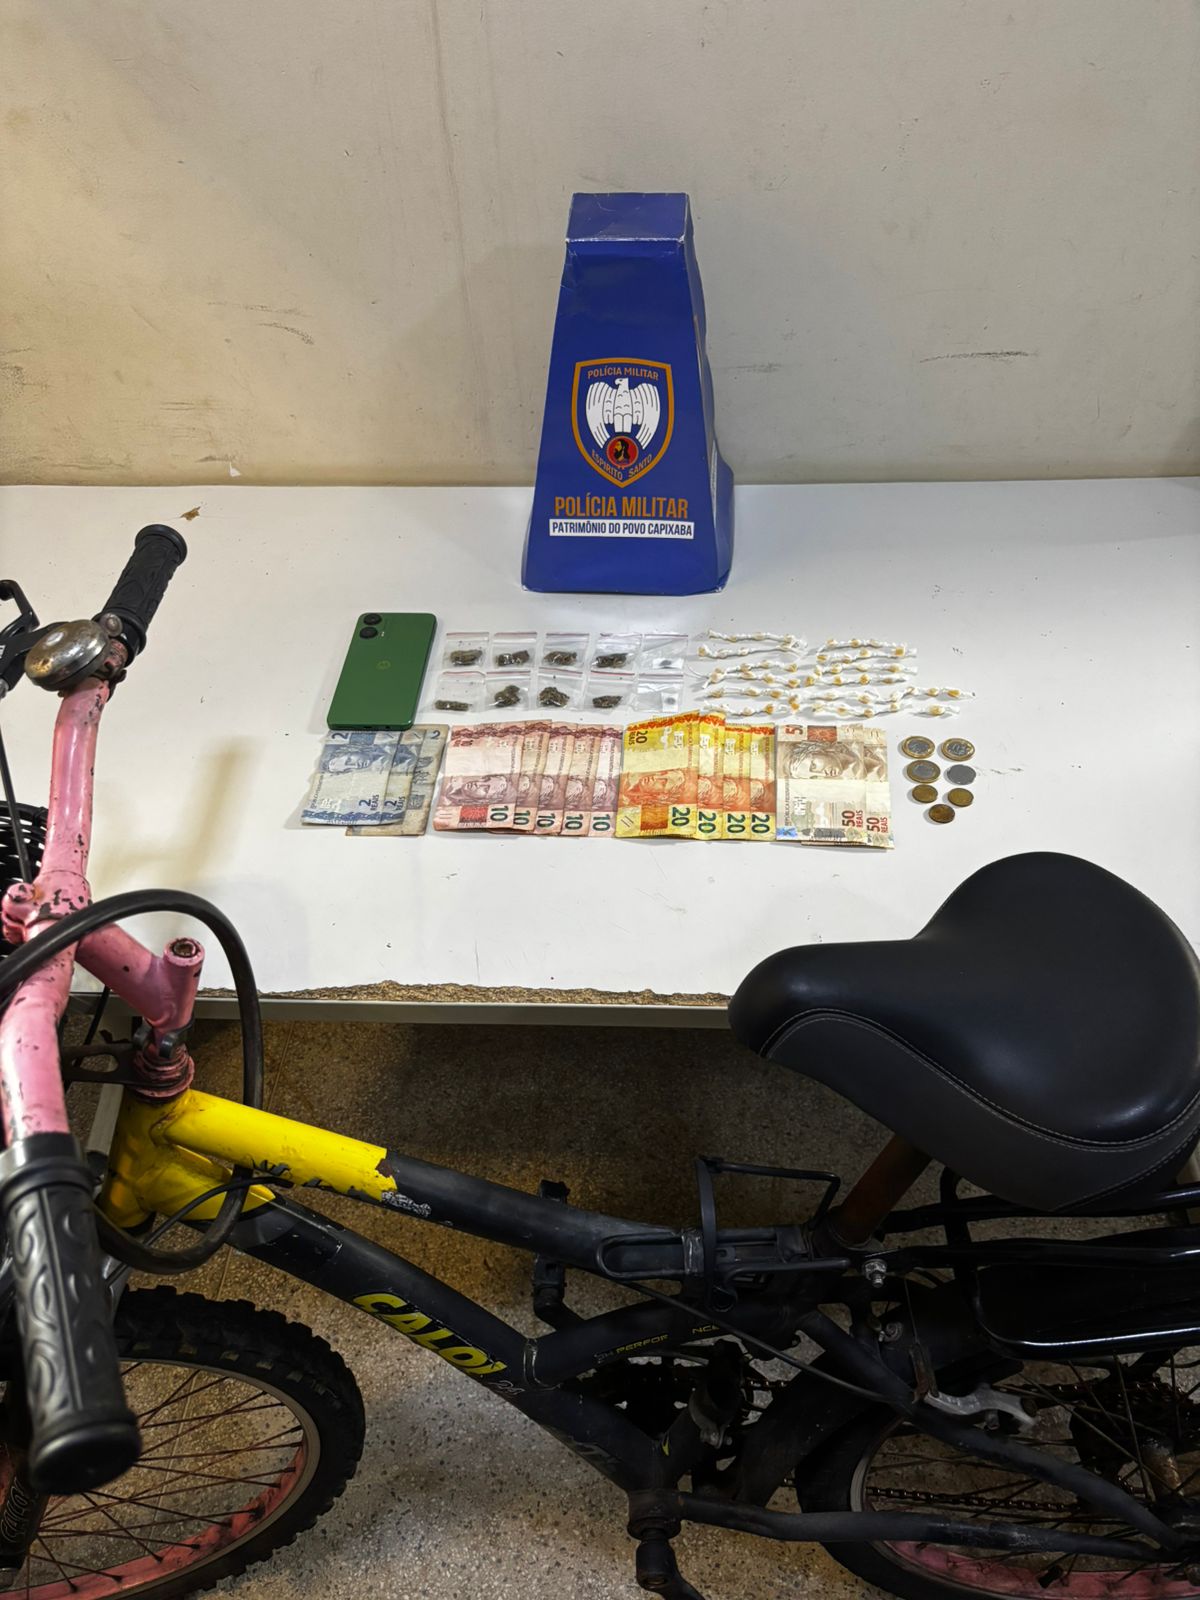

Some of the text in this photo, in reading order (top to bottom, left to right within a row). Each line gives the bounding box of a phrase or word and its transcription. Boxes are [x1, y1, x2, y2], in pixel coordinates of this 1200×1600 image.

[587, 365, 659, 381] POLÍCIA MILITAR
[628, 454, 653, 478] SANTO
[554, 492, 689, 518] POLÍCIA MILITAR
[552, 520, 692, 536] PATRIMÔNIO DO POVO CAPIXABA
[331, 732, 349, 741] 2
[635, 730, 648, 744] 20
[358, 799, 372, 807] 2
[384, 800, 398, 809] 2
[489, 805, 509, 822] 10
[513, 810, 530, 826] 10
[536, 813, 556, 828] 10
[671, 806, 691, 827] 20
[841, 810, 856, 827] 50
[855, 809, 864, 828] REAIS
[564, 814, 584, 831] 10
[592, 814, 611, 831] 10
[698, 811, 717, 834] 20
[727, 813, 746, 834] 20
[751, 814, 770, 834] 20
[866, 817, 880, 833] 50
[880, 816, 889, 833] REAIS
[353, 1293, 507, 1374] CALOI
